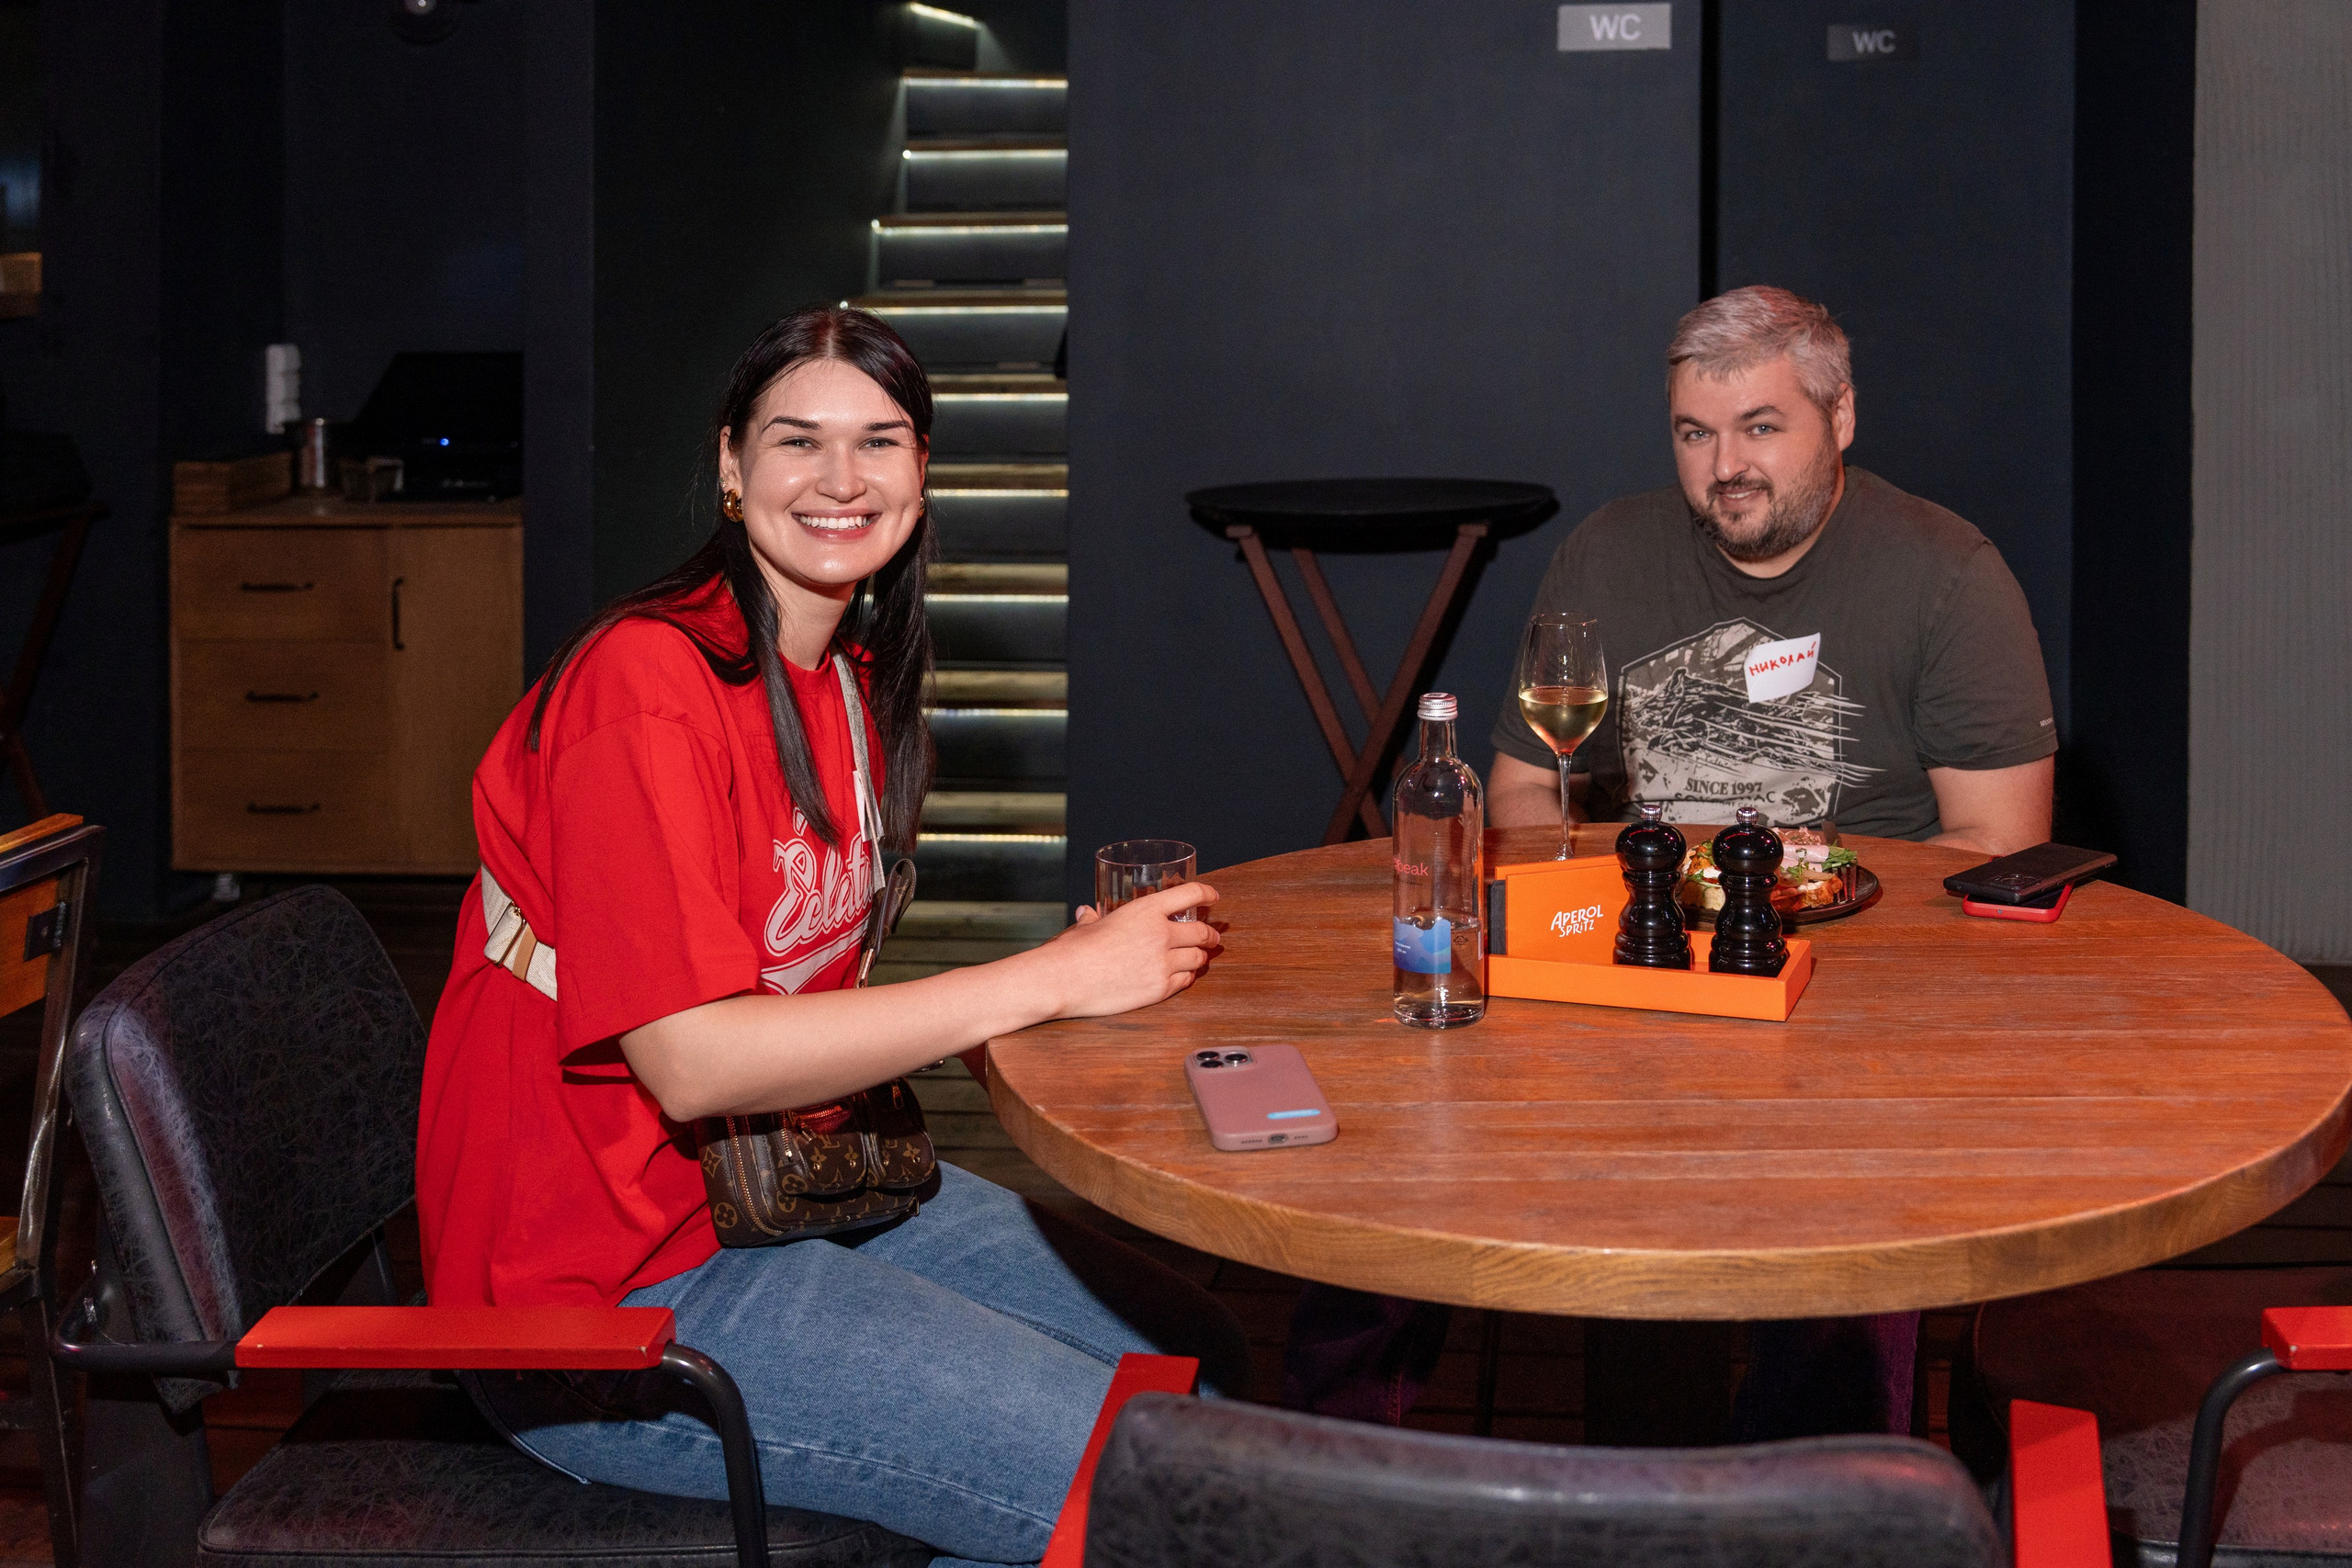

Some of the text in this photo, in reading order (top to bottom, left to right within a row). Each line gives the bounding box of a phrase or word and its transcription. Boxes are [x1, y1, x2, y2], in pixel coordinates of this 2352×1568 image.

[1589, 14, 1642, 41] WC
[1852, 29, 1896, 54] WC
[1748, 641, 1816, 676] НИКОЛАЙ
[1685, 777, 1763, 795] SINCE 1997
[1550, 905, 1604, 931] APEROL
